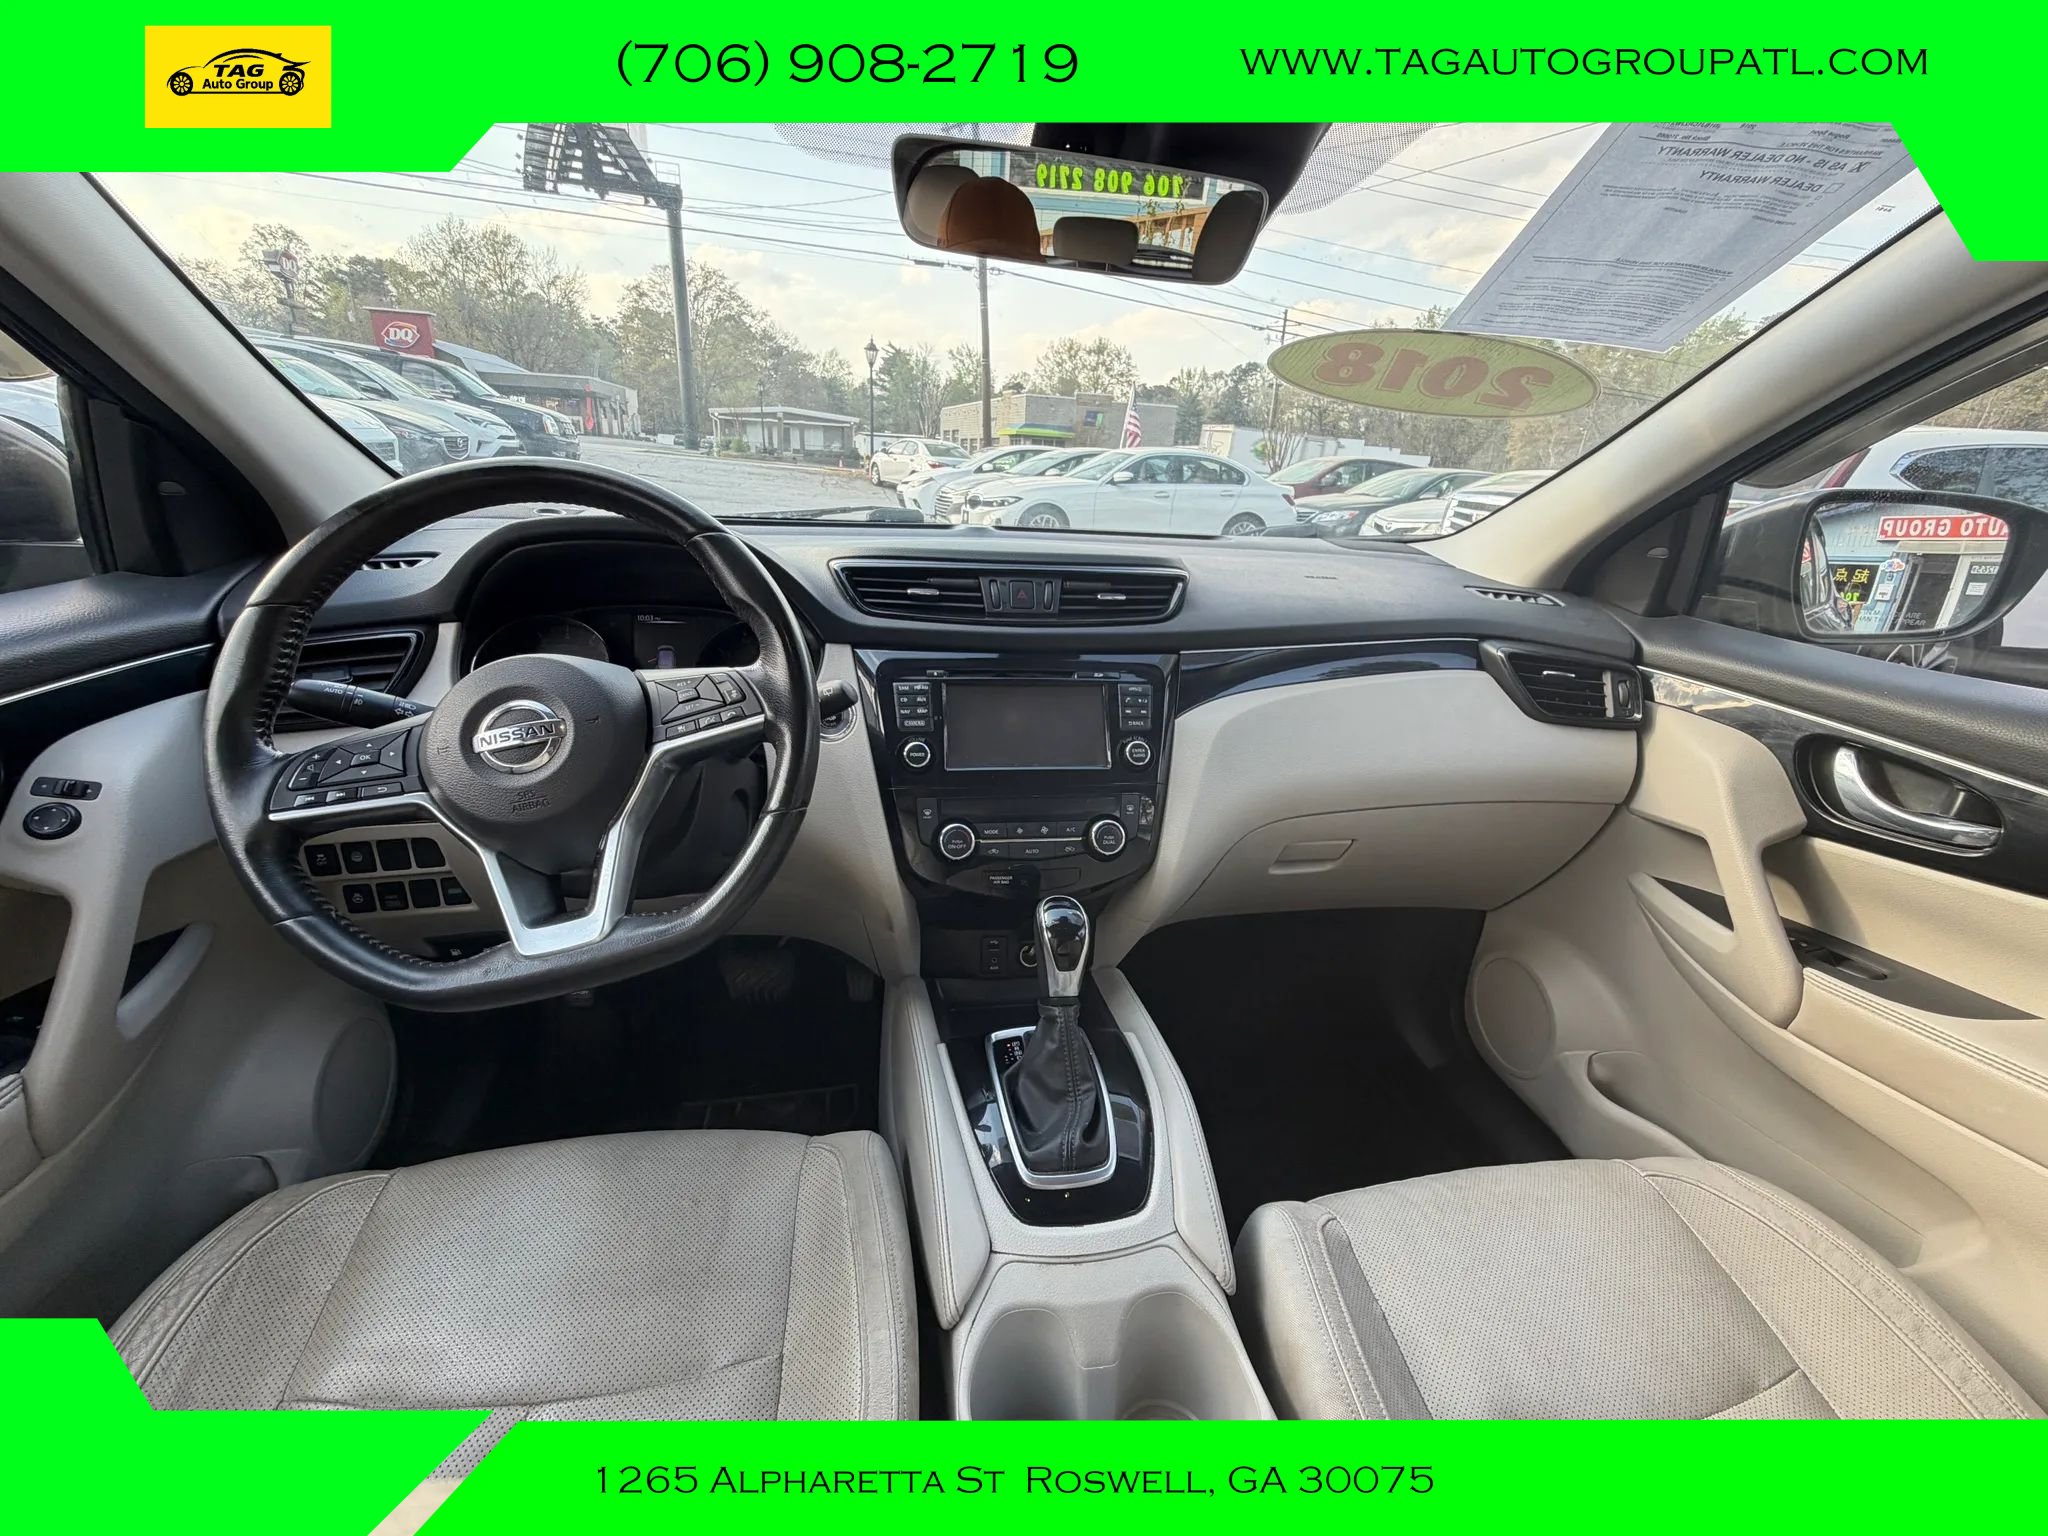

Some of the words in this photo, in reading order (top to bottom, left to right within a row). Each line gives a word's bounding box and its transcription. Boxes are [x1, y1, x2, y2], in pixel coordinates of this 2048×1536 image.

[282, 256, 298, 275] DQ
[389, 327, 414, 342] DQ
[324, 687, 343, 695] AUTO
[479, 722, 556, 749] NISSAN
[511, 798, 551, 813] AIRBAG
